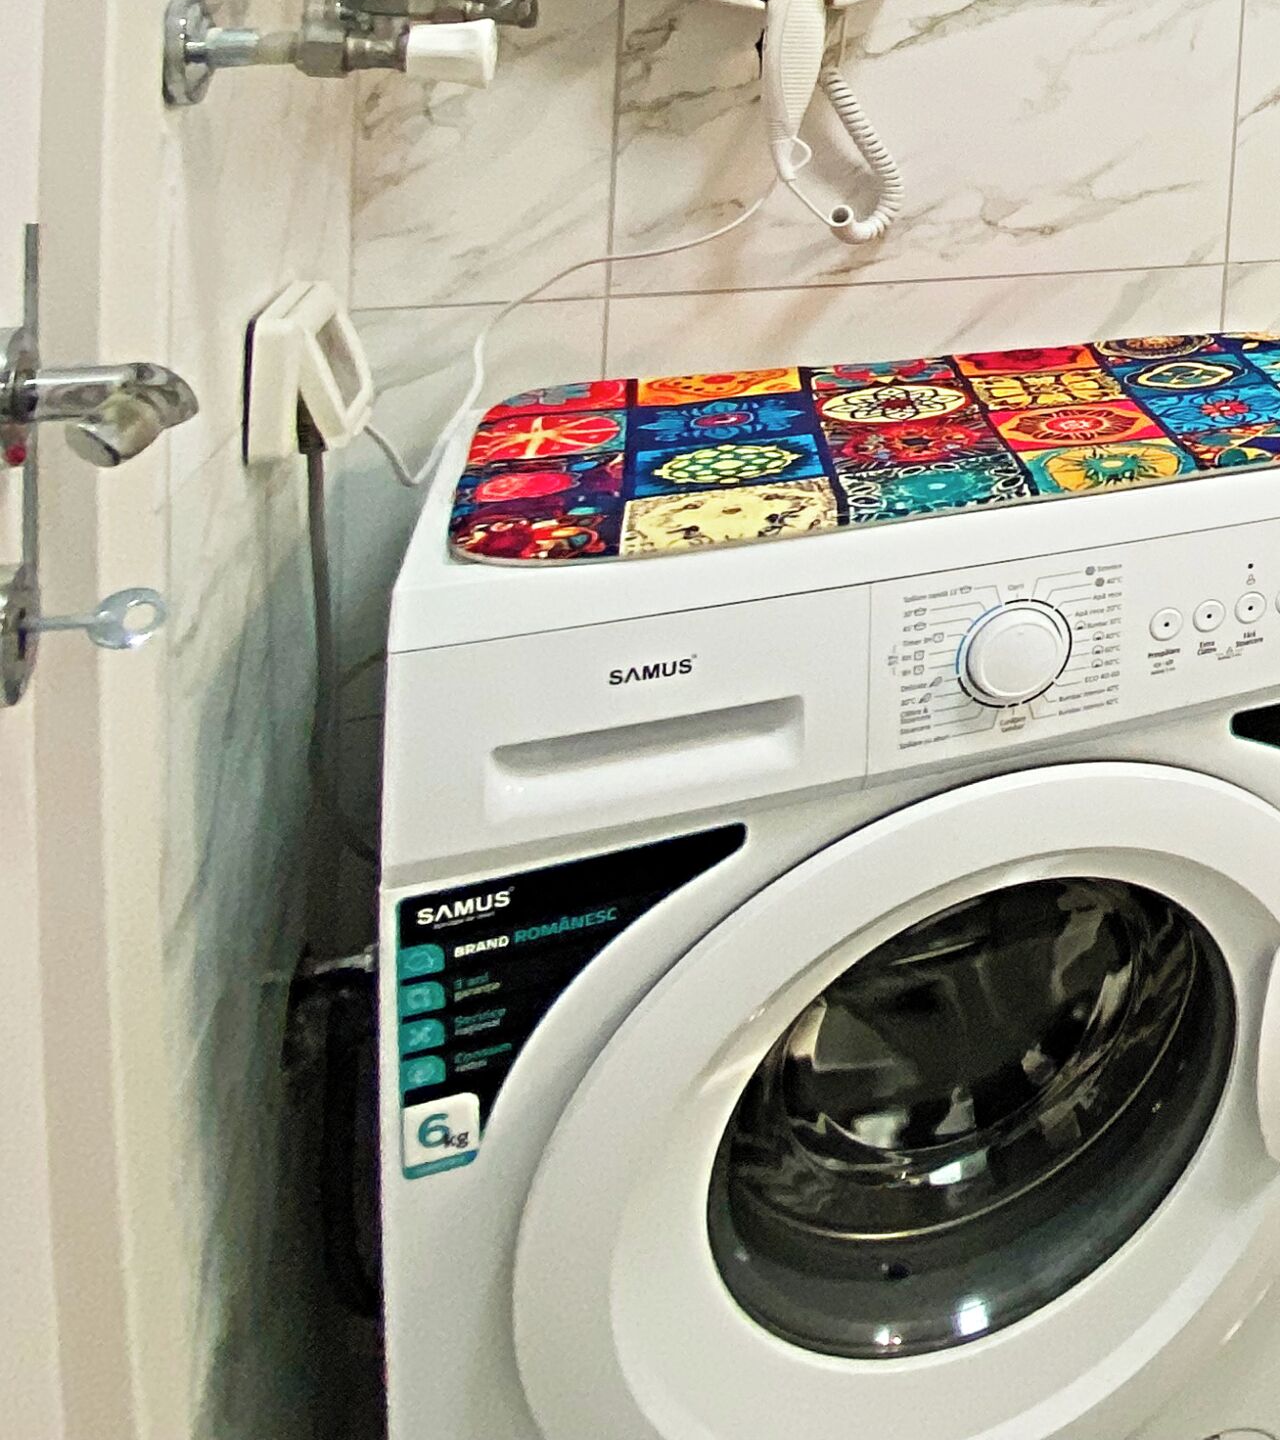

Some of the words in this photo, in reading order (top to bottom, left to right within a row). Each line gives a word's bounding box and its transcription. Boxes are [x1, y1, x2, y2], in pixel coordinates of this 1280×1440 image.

[608, 658, 693, 686] SAMUS
[416, 890, 511, 926] SAMUS
[453, 935, 510, 958] BRAND
[513, 907, 618, 944] ROMÂNESC
